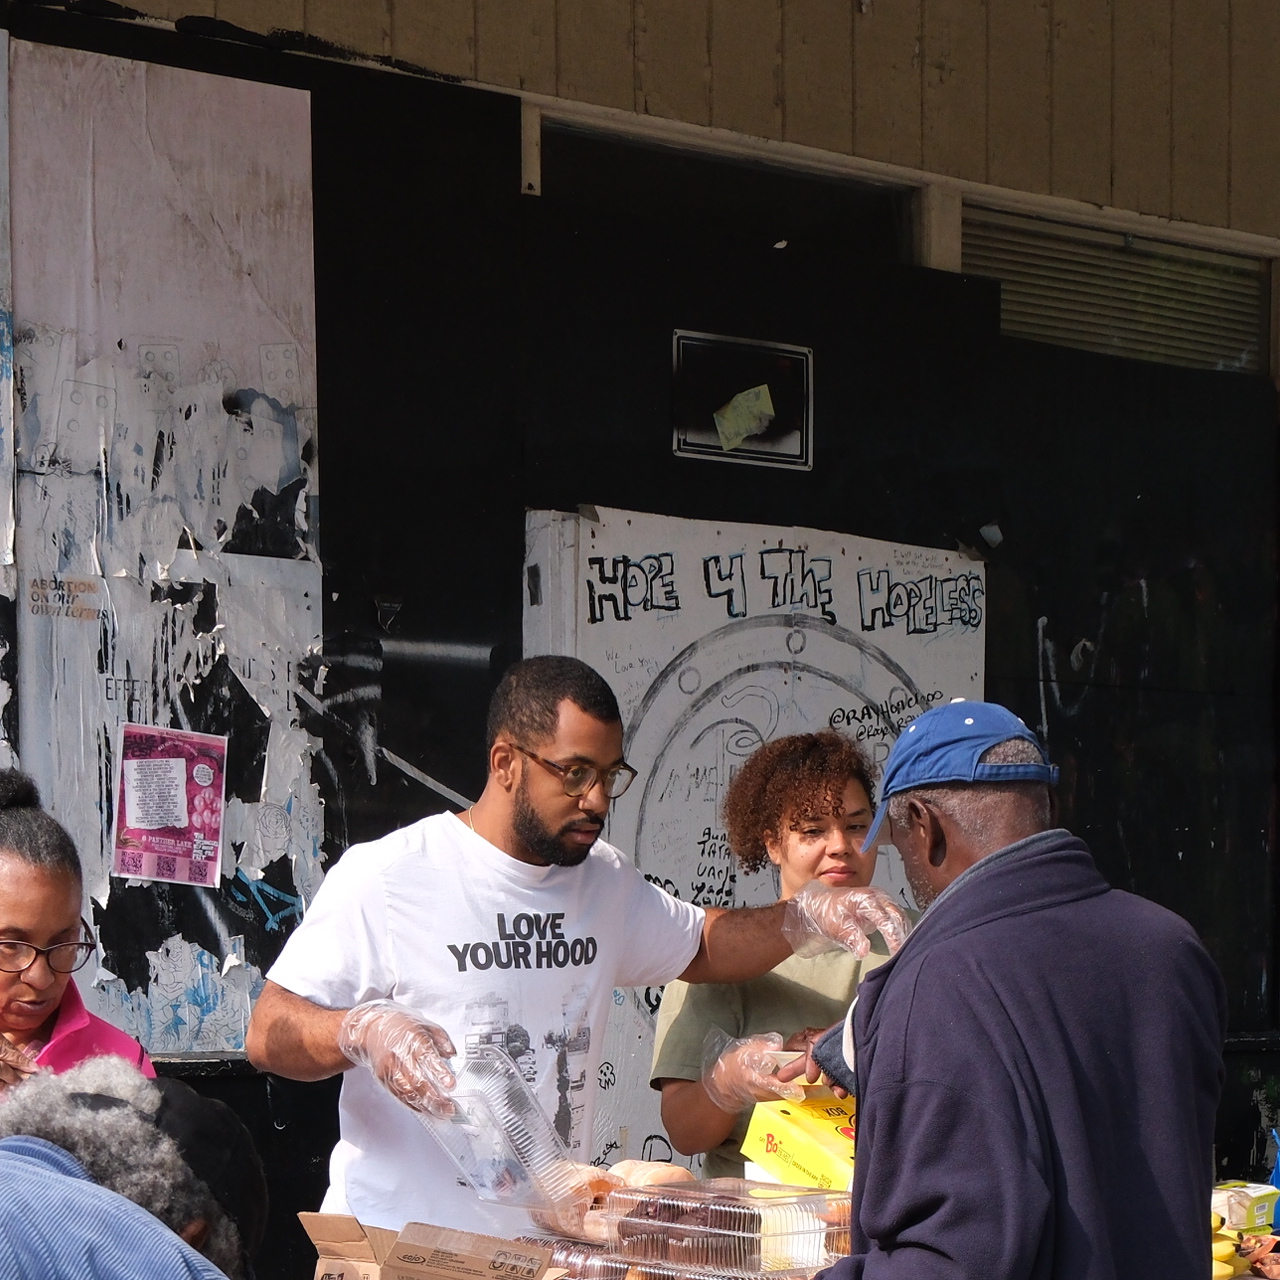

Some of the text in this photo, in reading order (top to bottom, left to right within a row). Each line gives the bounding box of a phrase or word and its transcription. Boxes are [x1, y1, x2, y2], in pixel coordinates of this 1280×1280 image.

[31, 578, 97, 594] ABORTION
[587, 552, 985, 634] HOPE 4 HOPELESS
[31, 591, 49, 603] ON
[31, 604, 62, 617] own
[614, 661, 635, 674] Love
[497, 912, 565, 941] LOVE
[447, 936, 597, 972] YOUR HOOD
